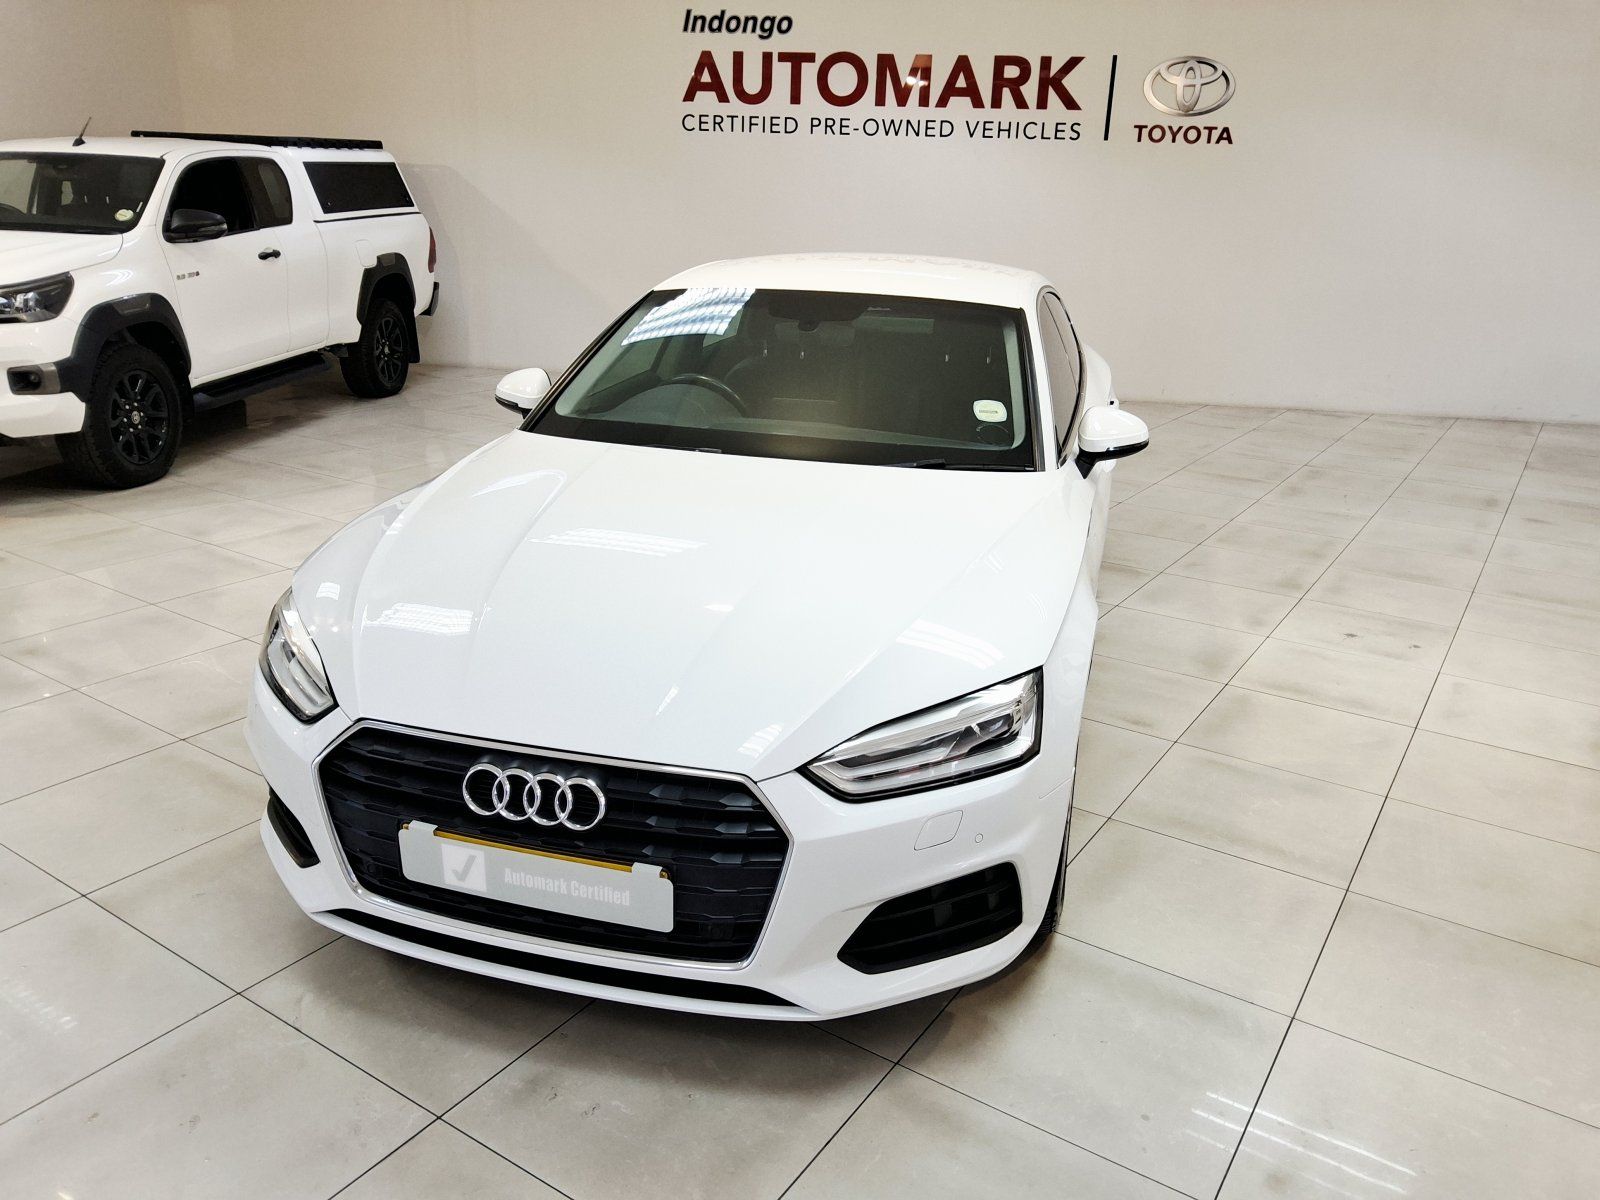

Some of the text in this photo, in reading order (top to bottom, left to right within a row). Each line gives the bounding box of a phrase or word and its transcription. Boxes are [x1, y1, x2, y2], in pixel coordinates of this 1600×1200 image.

[682, 9, 793, 40] Indongo
[682, 50, 1086, 111] AUTOMARK
[681, 113, 1082, 141] CERTIFIED PRE-OWNED VEHICLES
[1133, 124, 1234, 145] TOYOTA
[504, 867, 630, 906] Automark Certified
